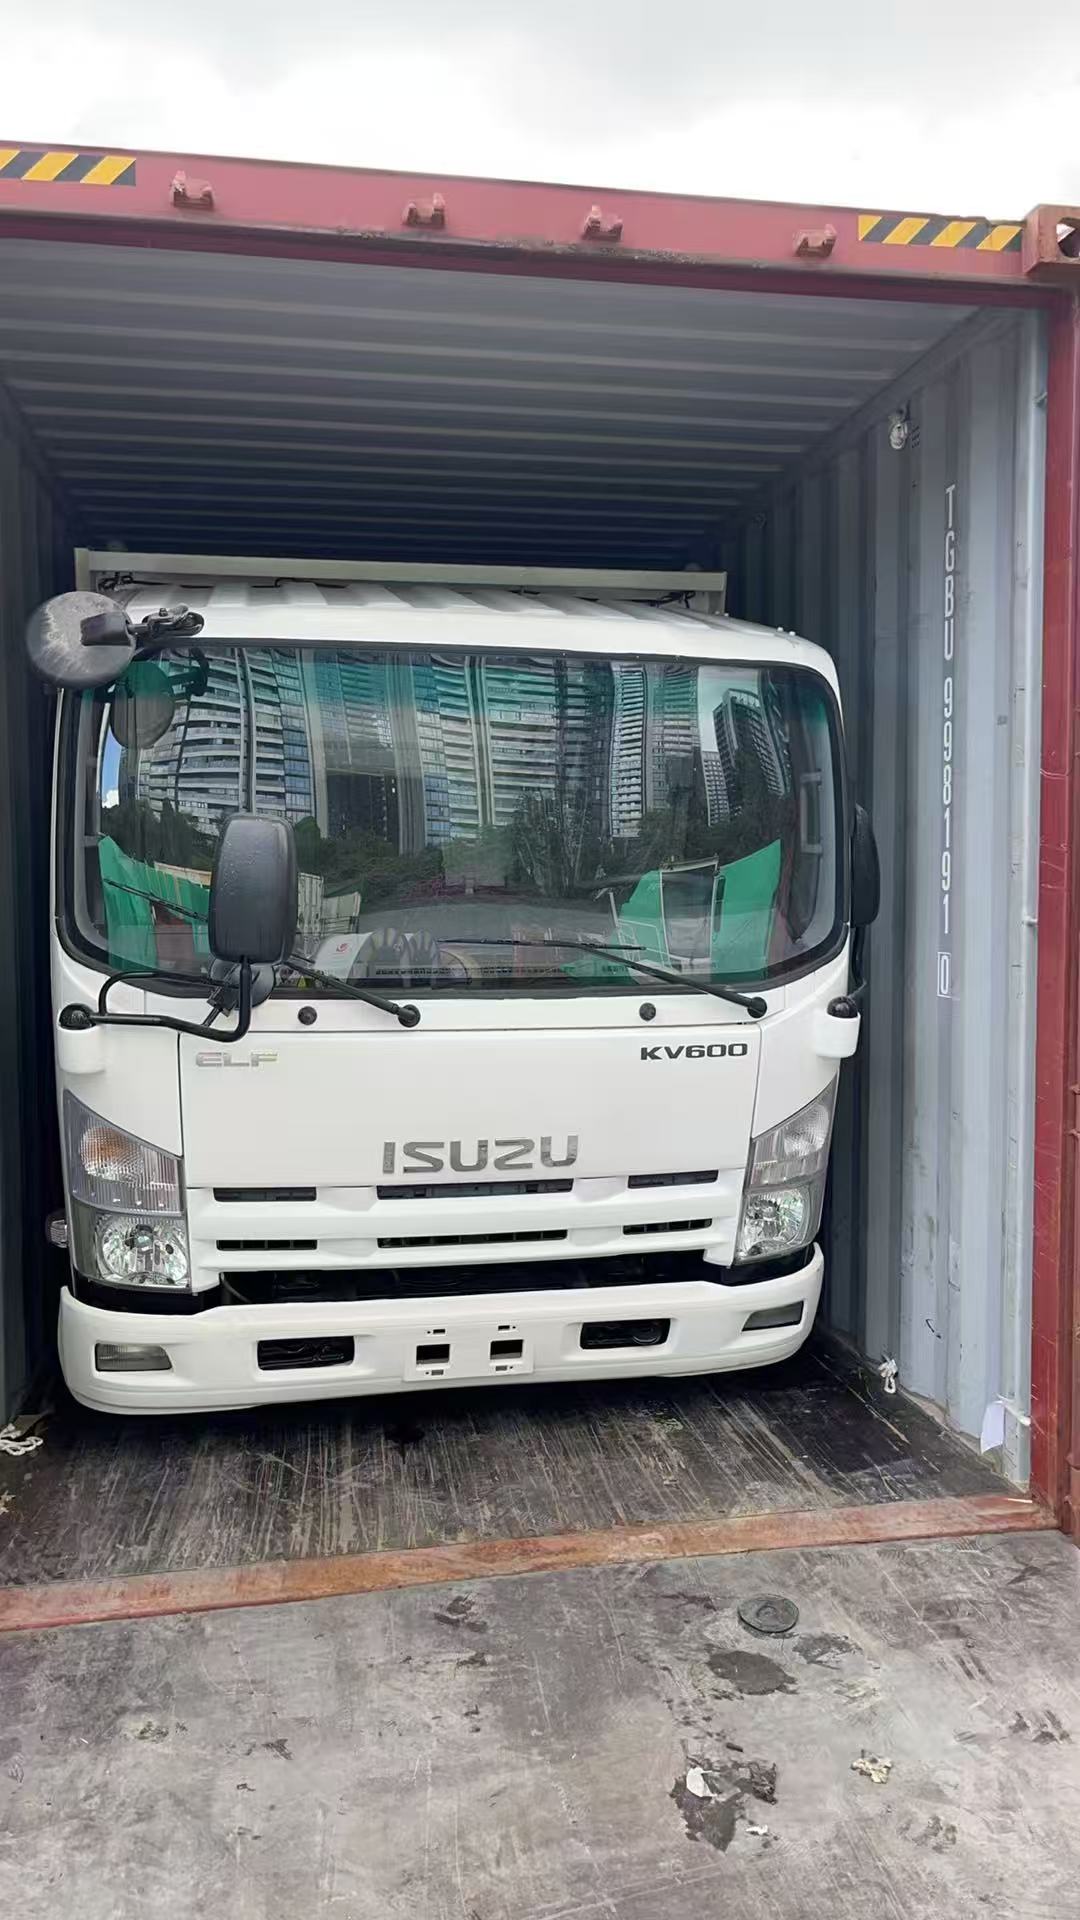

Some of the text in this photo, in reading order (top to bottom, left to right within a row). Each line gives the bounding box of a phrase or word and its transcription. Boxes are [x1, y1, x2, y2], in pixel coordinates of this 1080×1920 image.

[939, 484, 956, 996] TGBU 998191 0
[196, 1051, 278, 1067] ELF
[640, 1043, 748, 1060] KV600
[382, 1135, 579, 1174] ISUZU
